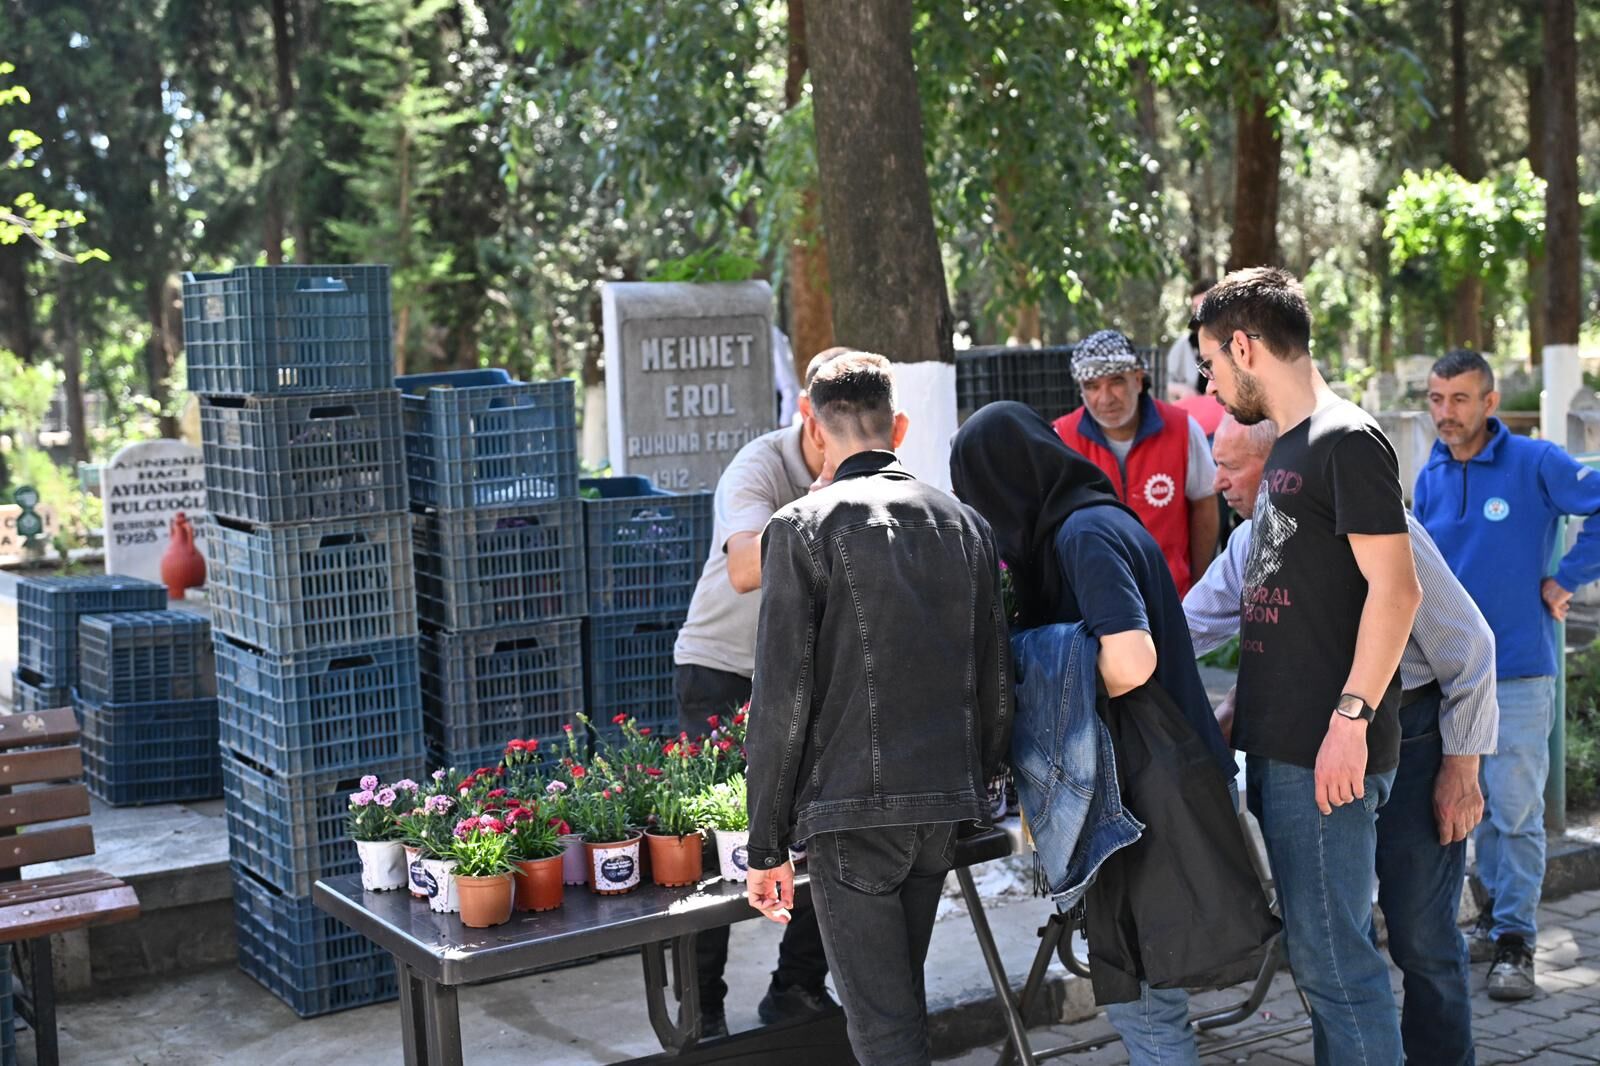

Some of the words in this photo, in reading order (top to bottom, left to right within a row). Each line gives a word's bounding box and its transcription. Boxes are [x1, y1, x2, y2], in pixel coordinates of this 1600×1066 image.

[641, 334, 754, 371] MEHMET
[664, 383, 737, 418] EROL
[629, 431, 700, 458] RUHUNA
[110, 495, 207, 515] PULCUOĞL
